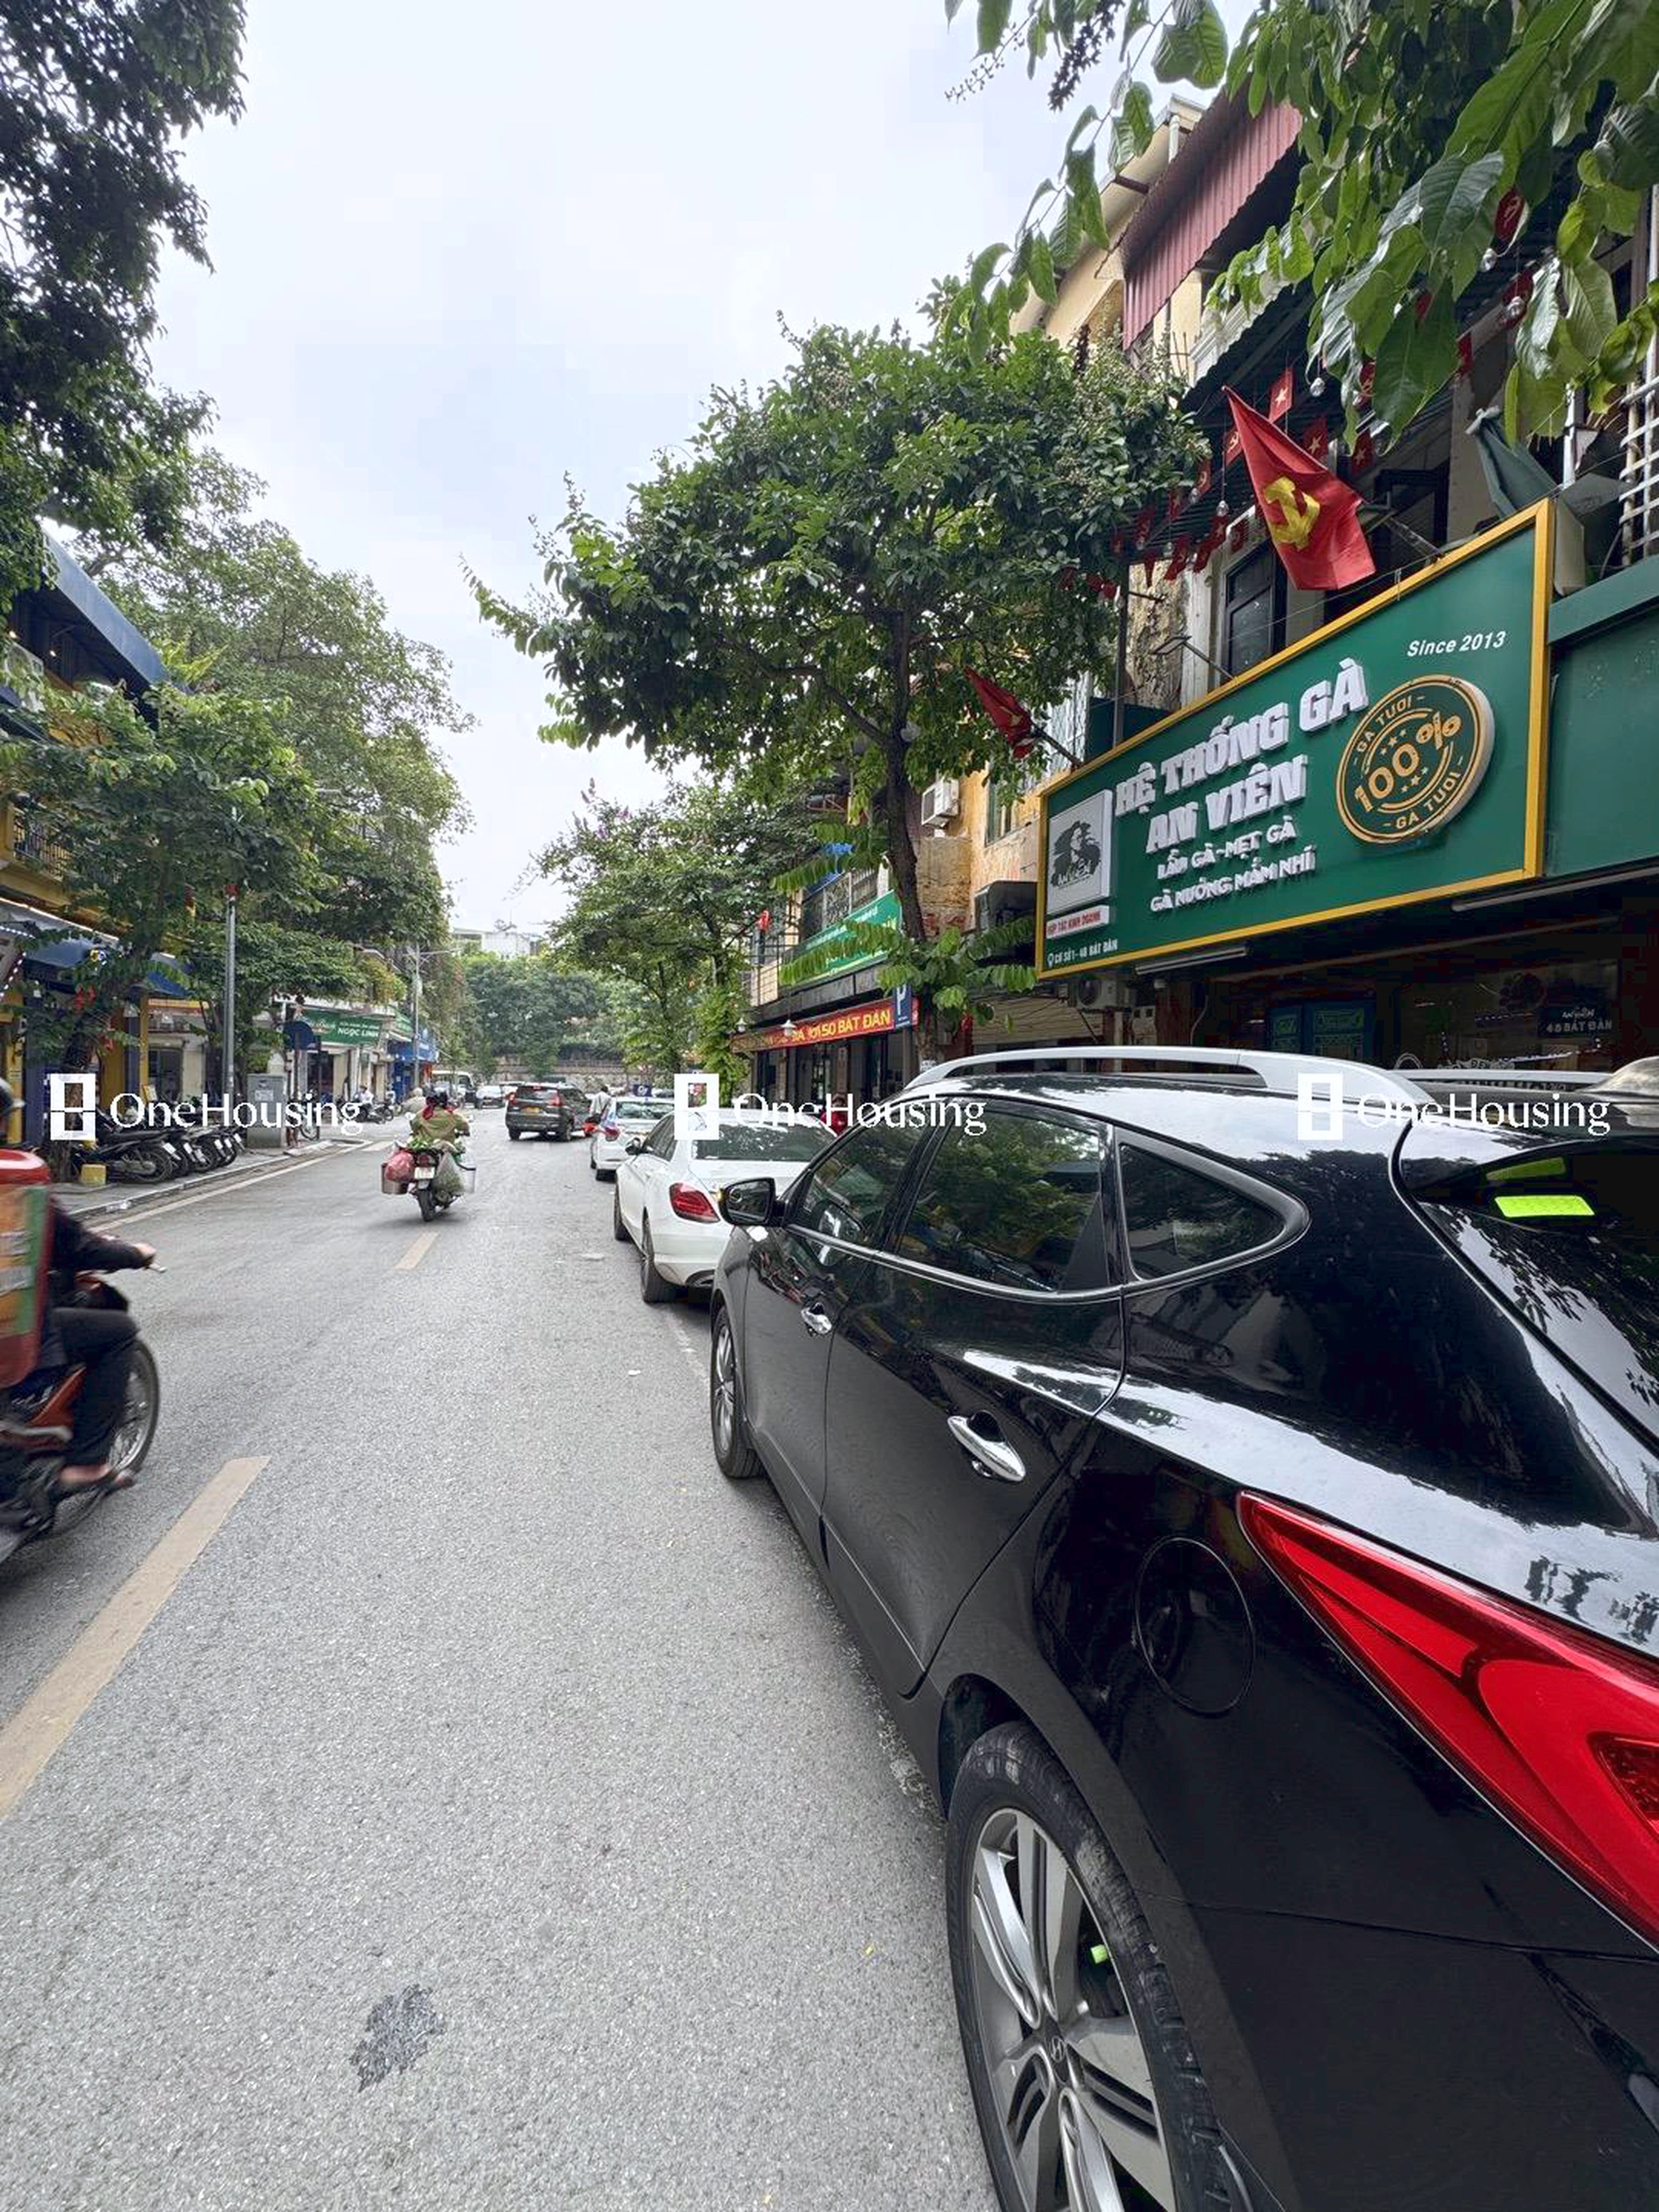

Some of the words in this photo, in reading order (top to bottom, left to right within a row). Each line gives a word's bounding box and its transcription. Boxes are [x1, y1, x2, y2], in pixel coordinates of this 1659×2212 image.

[1407, 640, 1457, 657] Since
[1459, 631, 1507, 651] 2013
[1116, 761, 1156, 817] HỆ
[1161, 701, 1289, 795] THỐNG
[1299, 656, 1370, 732] GÀ
[1353, 710, 1462, 813] 100%
[1145, 801, 1199, 853] AN
[1205, 753, 1308, 831] VIÊN
[1266, 814, 1297, 844] GÀ
[1150, 888, 1174, 912] GÀ
[863, 1008, 890, 1029] ĐÀN
